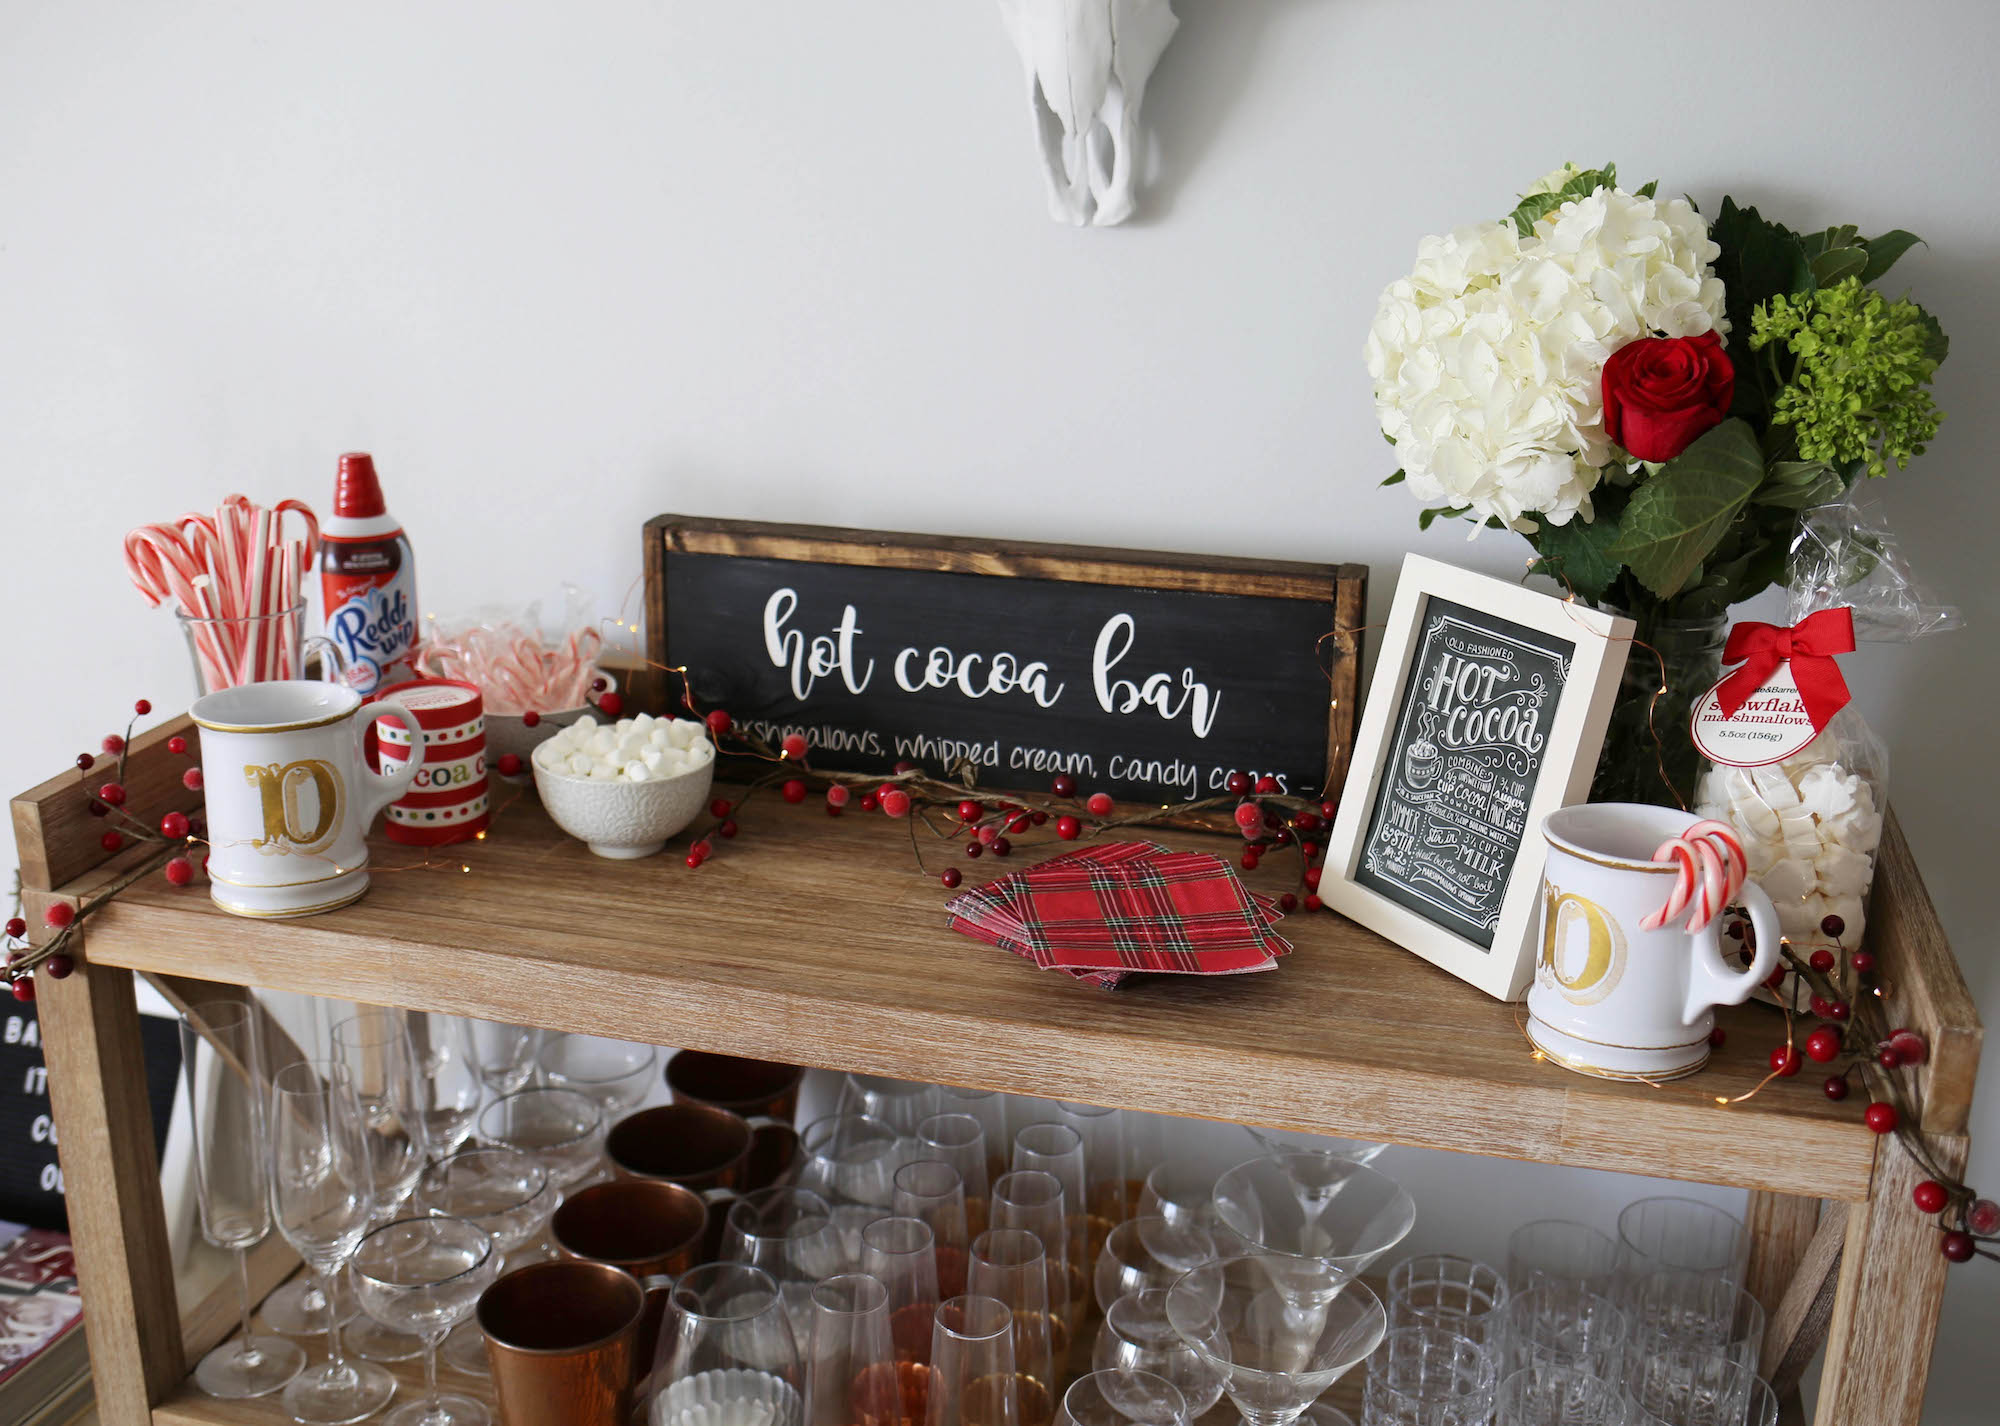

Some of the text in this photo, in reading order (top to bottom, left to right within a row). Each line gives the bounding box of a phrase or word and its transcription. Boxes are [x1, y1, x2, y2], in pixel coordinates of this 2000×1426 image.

[335, 590, 407, 662] Reddi
[380, 620, 413, 655] wip
[1449, 637, 1514, 660] OLD FASHIONED
[763, 588, 1220, 738] hot cocoa bar
[1427, 653, 1511, 717] HOT
[1702, 713, 1813, 726] marshmallows
[1719, 730, 1783, 742] 5.5oz (156g)
[895, 733, 1000, 772] whipped
[1010, 745, 1097, 778] cream,
[1109, 755, 1199, 800] candy
[1448, 756, 1488, 779] COMBINE:
[1437, 778, 1488, 811] CUP Cocoa
[1493, 789, 1528, 812] sugar
[1509, 781, 1526, 798] CUP
[1388, 801, 1420, 836] SIMMER
[1425, 801, 1446, 818] Blend
[1469, 820, 1489, 835] BOILING
[1444, 795, 1481, 818] POWDER
[1488, 803, 1507, 829] PINCH
[1505, 819, 1523, 835] SALT
[1456, 844, 1505, 881] MILK
[1479, 840, 1505, 860] CUPS
[1385, 859, 1406, 877] MINUTES
[1433, 854, 1452, 869] but
[1446, 864, 1457, 875] do
[1456, 872, 1475, 886] not
[1472, 876, 1495, 893] boil
